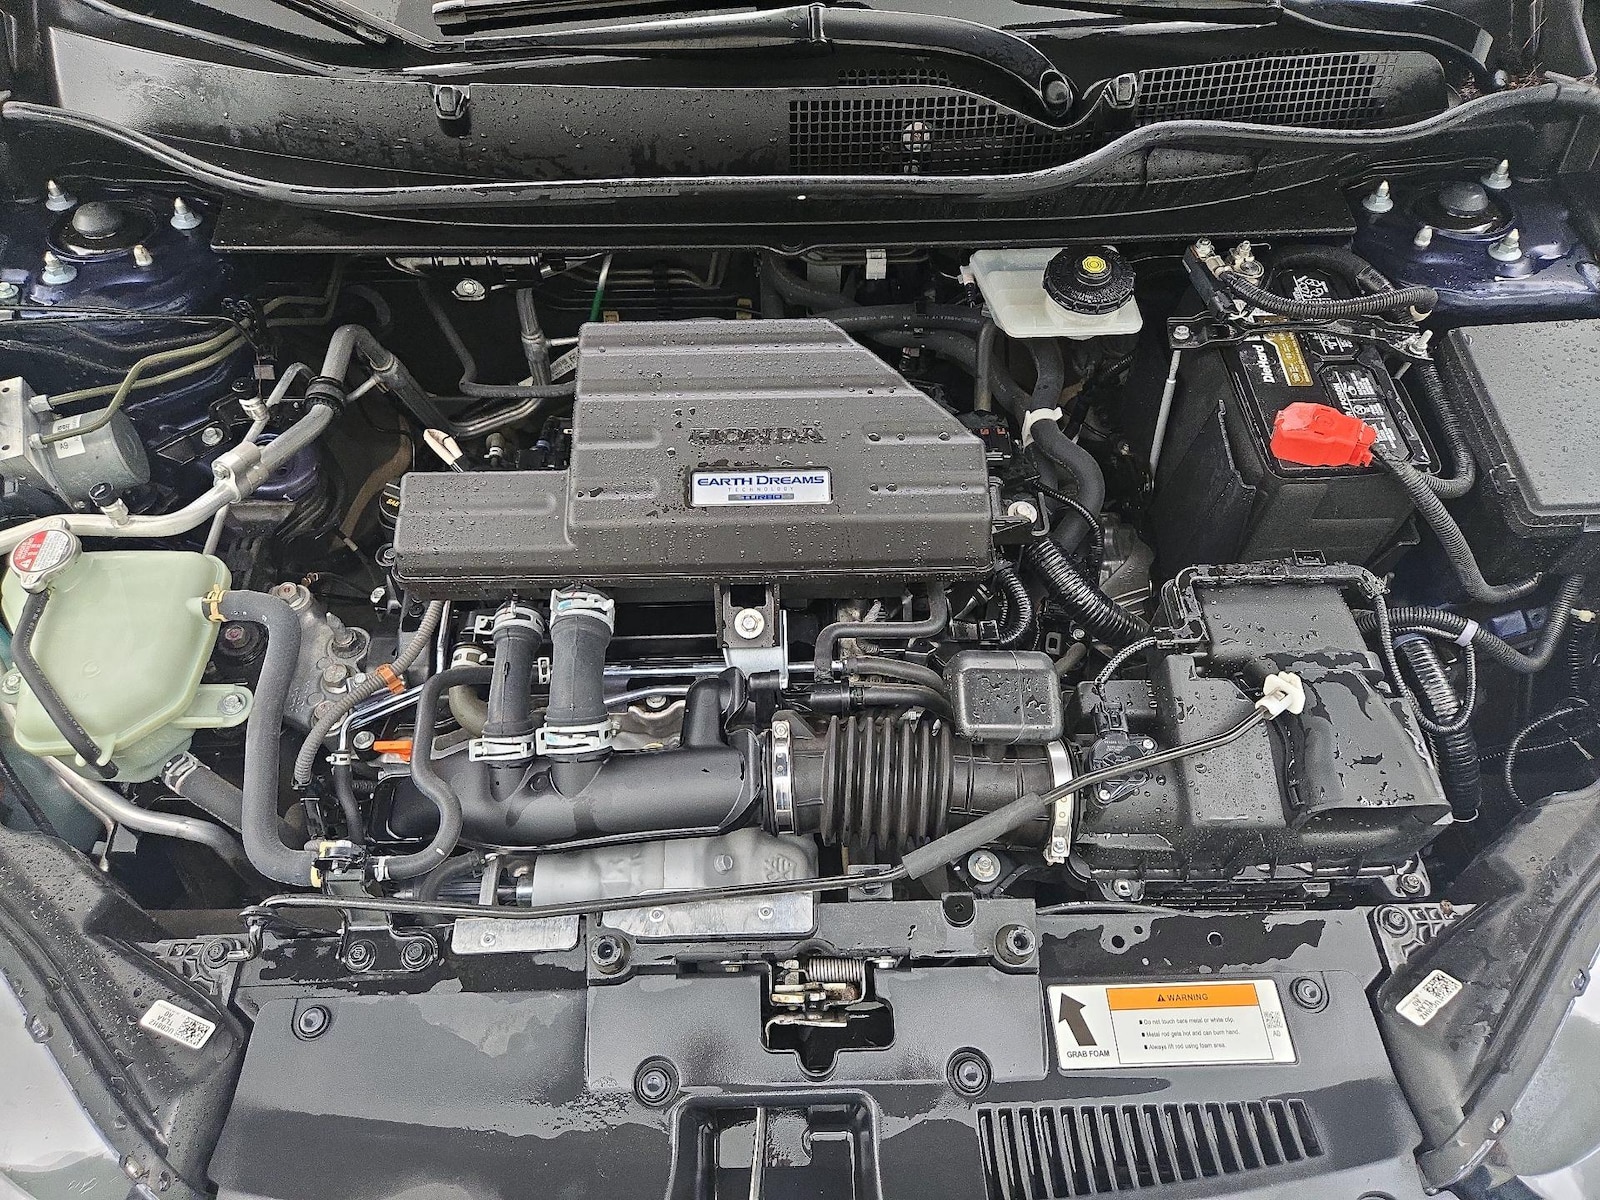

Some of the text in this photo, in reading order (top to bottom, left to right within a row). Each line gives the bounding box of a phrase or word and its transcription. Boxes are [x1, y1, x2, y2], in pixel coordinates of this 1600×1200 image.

[1252, 344, 1275, 383] DieHard
[1332, 383, 1349, 406] POISON
[688, 427, 827, 446] HONDA
[697, 475, 825, 486] EARTH DREAMS
[1167, 993, 1208, 1002] WARNING
[1066, 1049, 1110, 1058] GRAB FOAM
